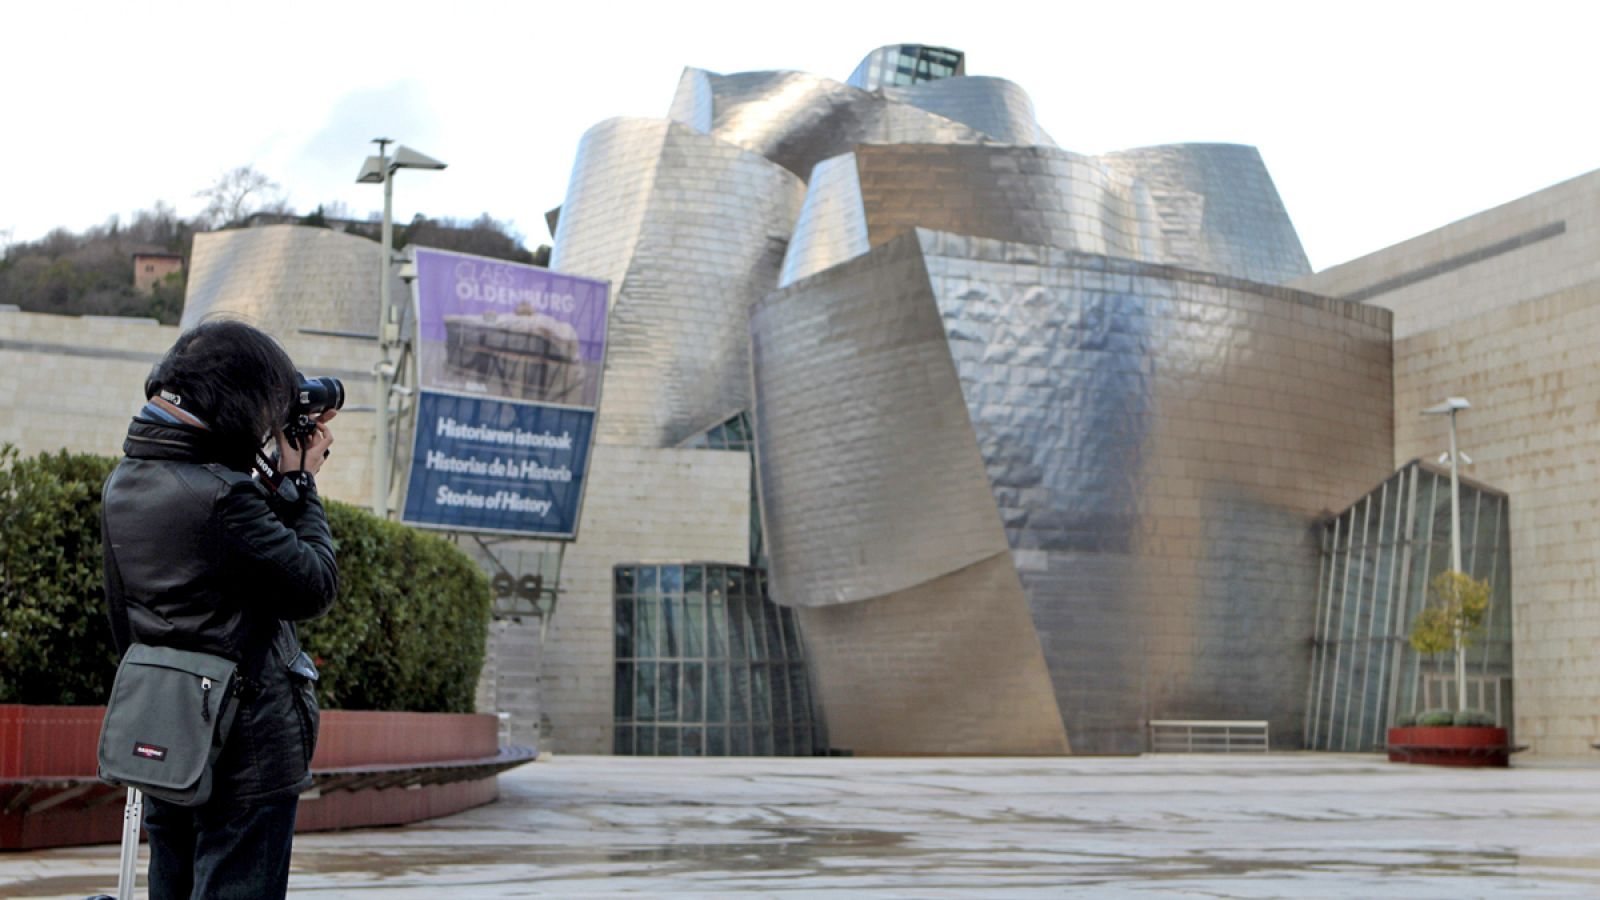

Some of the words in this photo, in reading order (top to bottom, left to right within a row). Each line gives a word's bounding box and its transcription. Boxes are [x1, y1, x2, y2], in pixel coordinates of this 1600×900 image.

[455, 281, 577, 313] OLDENBURG
[436, 416, 514, 444] Historiaren
[515, 427, 573, 449] istorioak
[425, 450, 488, 475] Historias
[488, 457, 506, 477] de
[506, 459, 519, 478] la
[520, 460, 573, 483] Historia
[435, 484, 485, 509] Stories
[485, 491, 503, 510] of
[501, 491, 552, 523] History
